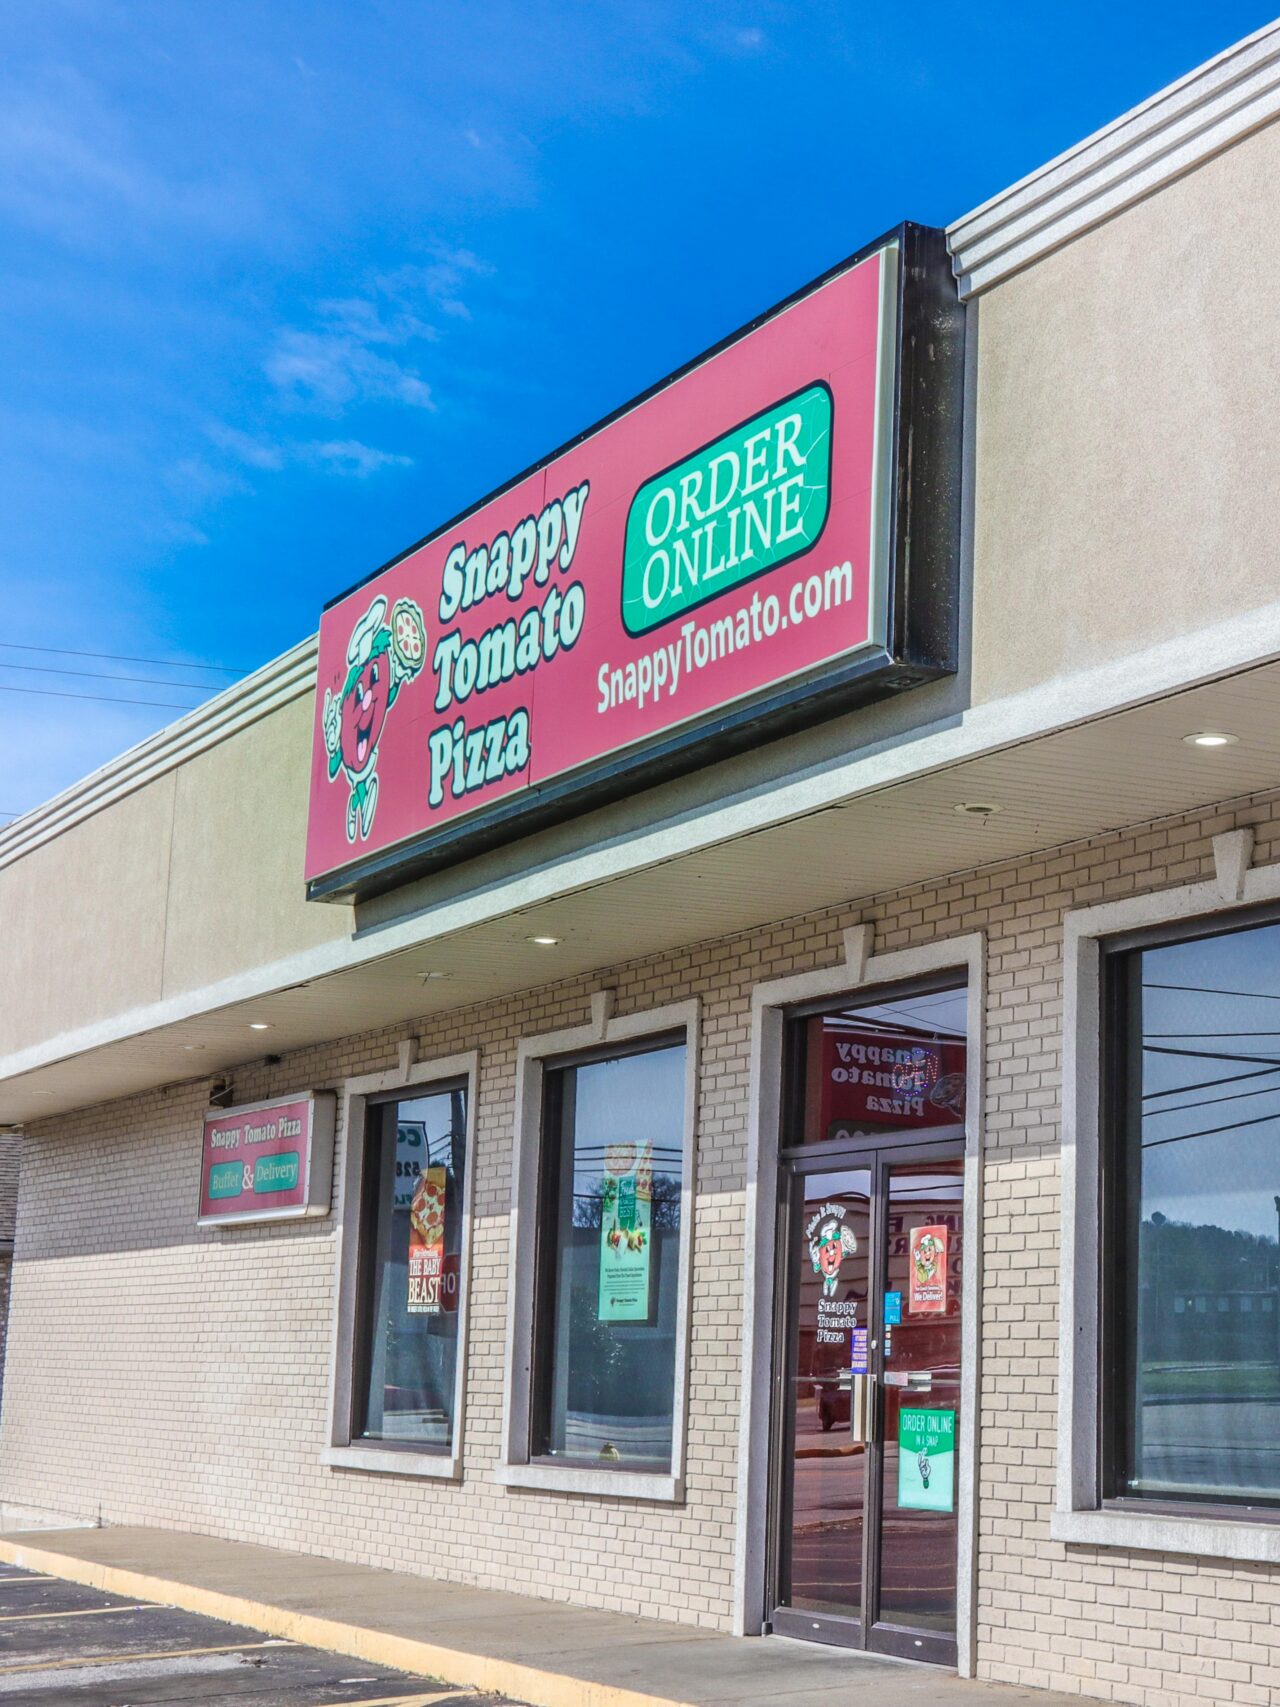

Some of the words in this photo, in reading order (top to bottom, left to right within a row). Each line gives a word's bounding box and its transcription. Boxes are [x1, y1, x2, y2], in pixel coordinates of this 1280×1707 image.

[644, 413, 807, 548] ORDER
[438, 479, 589, 624] Snappy
[642, 472, 805, 608] ONLINE
[433, 580, 586, 713] Tomato
[597, 560, 853, 713] SnappyTomato.com
[427, 706, 530, 808] Pizza
[211, 1128, 241, 1149] Snappy
[243, 1123, 276, 1144] Tomato
[278, 1117, 301, 1138] Pizza
[213, 1170, 239, 1190] Buffet
[242, 1164, 254, 1190] &
[256, 1162, 297, 1182] Delivery
[409, 1259, 421, 1276] THE
[423, 1258, 441, 1275] BABY
[408, 1277, 440, 1303] BEAST
[914, 1292, 922, 1301] We
[818, 1299, 857, 1315] Snappy
[817, 1314, 857, 1328] Tomato
[817, 1329, 845, 1342] Pizza
[903, 1414, 925, 1432] ORDER
[927, 1415, 952, 1433] ONLINE
[916, 1435, 921, 1445] IN
[926, 1435, 939, 1447] SNAP
